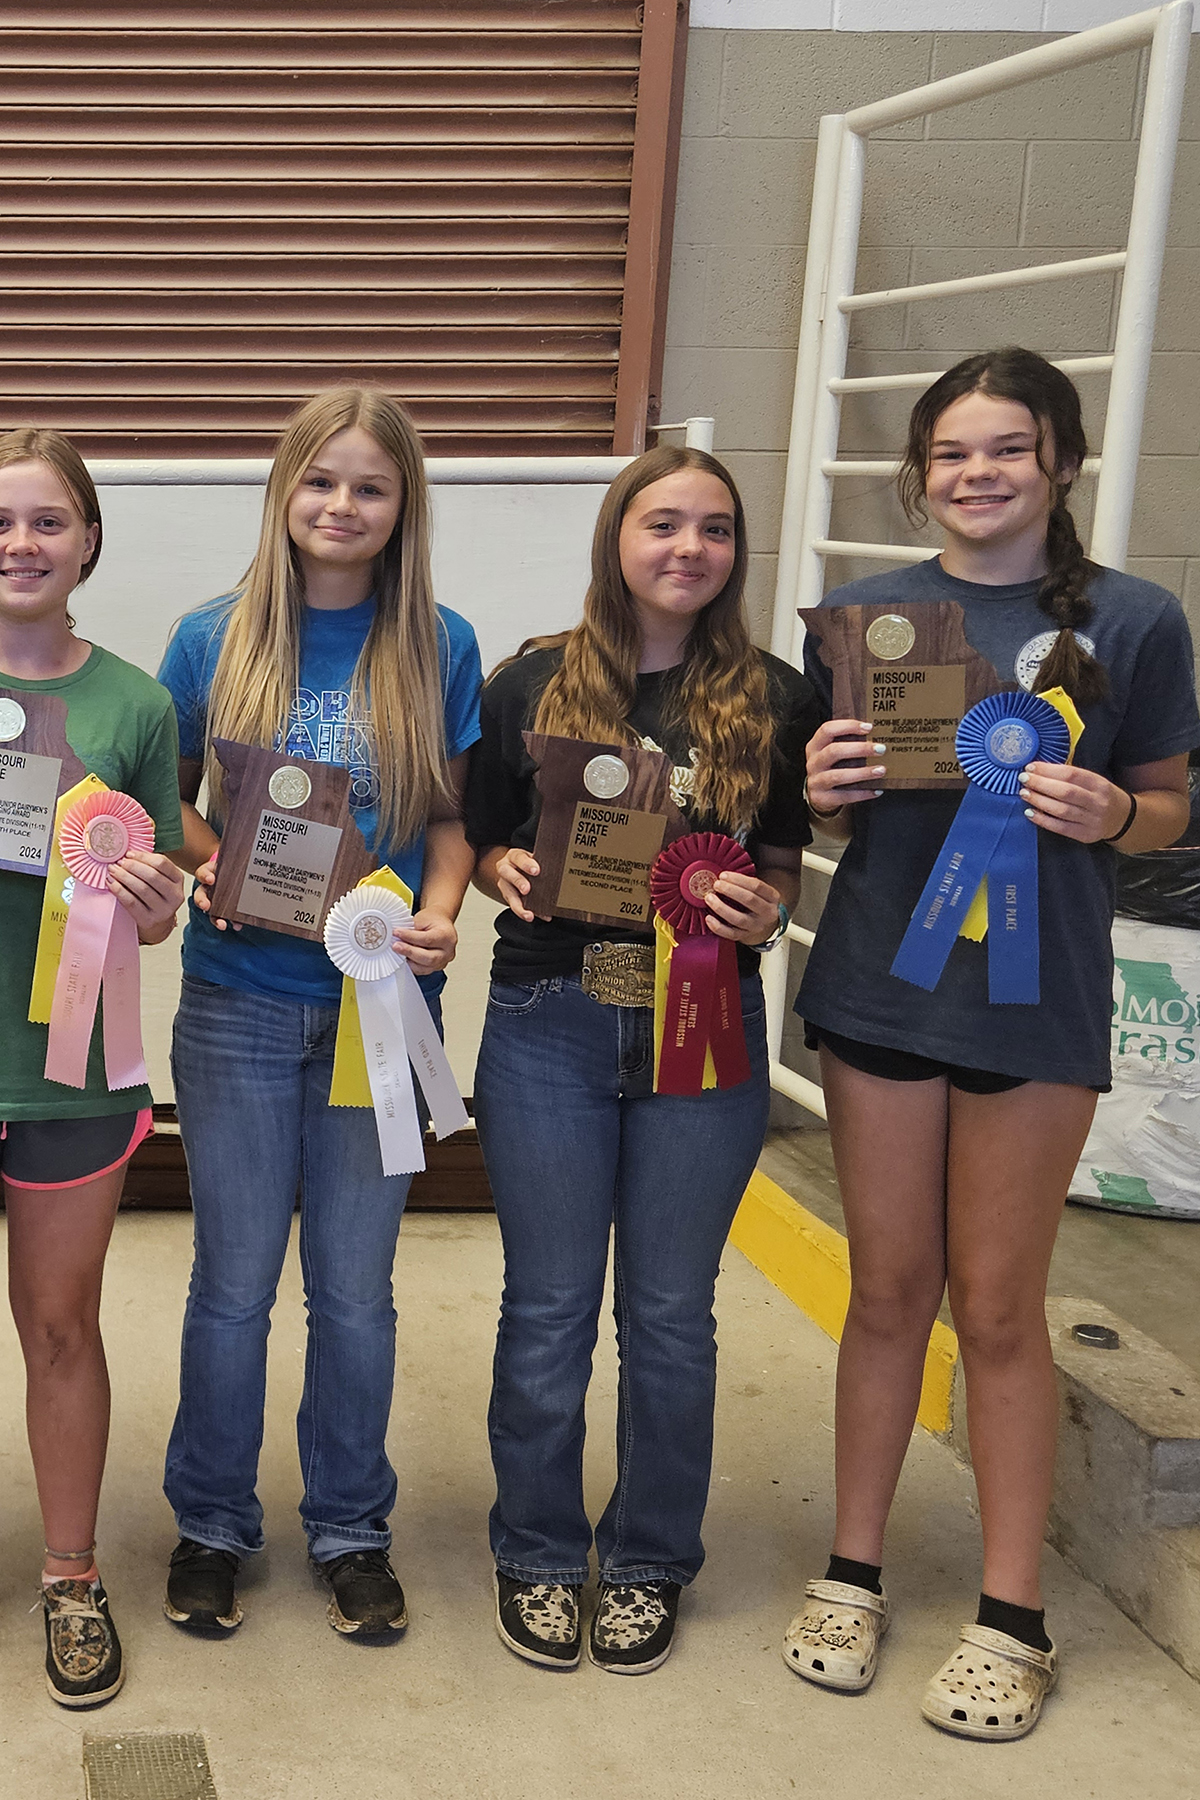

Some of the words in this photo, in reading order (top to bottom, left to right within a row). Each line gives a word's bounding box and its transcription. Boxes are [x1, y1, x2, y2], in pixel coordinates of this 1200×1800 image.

[1027, 633, 1057, 651] DALLA
[873, 672, 926, 684] MISSOURI
[872, 686, 905, 699] STATE
[872, 700, 896, 712] FAIR
[873, 718, 900, 727] SHOW-ME
[901, 718, 922, 727] JUNIOR
[891, 726, 917, 734] JUDGING
[872, 736, 912, 744] INTERMEDIATE
[914, 736, 939, 744] DIVISION
[934, 761, 960, 774] 2024
[0, 800, 17, 809] JUNIOR
[17, 803, 48, 814] DAIRYMEN'S
[12, 810, 31, 818] AWARD
[6, 817, 28, 828] DIVISION
[580, 807, 629, 825] MISSOURI
[262, 815, 308, 836] MISSOURI
[577, 821, 608, 836] STATE
[9, 829, 31, 838] PLACE
[259, 828, 288, 845] STATE
[575, 833, 597, 847] FAIR
[19, 846, 42, 859] 2024
[256, 841, 277, 855] FAIR
[572, 851, 598, 861] SHOW-ME
[599, 855, 618, 866] JUNIOR
[253, 858, 277, 869] SHOW-ME
[277, 864, 295, 875] JUNIOR
[295, 868, 325, 882] DAIRYMEN'S
[588, 861, 612, 871] JUDGING
[612, 866, 632, 875] AWARD
[248, 874, 283, 888] INTERMEDIATE
[283, 882, 305, 893] DIVISION
[267, 869, 289, 880] JUDGING
[289, 875, 307, 884] AWARD
[568, 868, 606, 880] INTERMEDIATE
[607, 874, 630, 884] DIVISION
[580, 880, 609, 889] SECOND
[610, 885, 633, 893] PLACE
[923, 894, 945, 930] MISSOURI
[938, 871, 955, 894] STATE
[949, 852, 965, 871] FAIR
[1005, 884, 1017, 904] FIRST
[262, 887, 281, 896] THIRD
[283, 892, 303, 902] PLACE
[620, 902, 643, 915] 2024
[294, 910, 315, 924] 2024
[1005, 908, 1017, 931] PLACE
[595, 957, 642, 972] AYRSHIRE
[67, 973, 79, 994] STATE
[593, 973, 625, 986] JUNIOR
[682, 981, 692, 997] FAIR
[719, 987, 728, 1012] SECOND
[679, 997, 690, 1019] STATE
[687, 1003, 699, 1029] SEDALIA
[720, 1011, 731, 1030] PLACE
[675, 1019, 687, 1048] MISSOURI
[374, 1041, 385, 1058] FAIR
[417, 1038, 430, 1059] THIRD
[425, 1058, 438, 1079] PLACE
